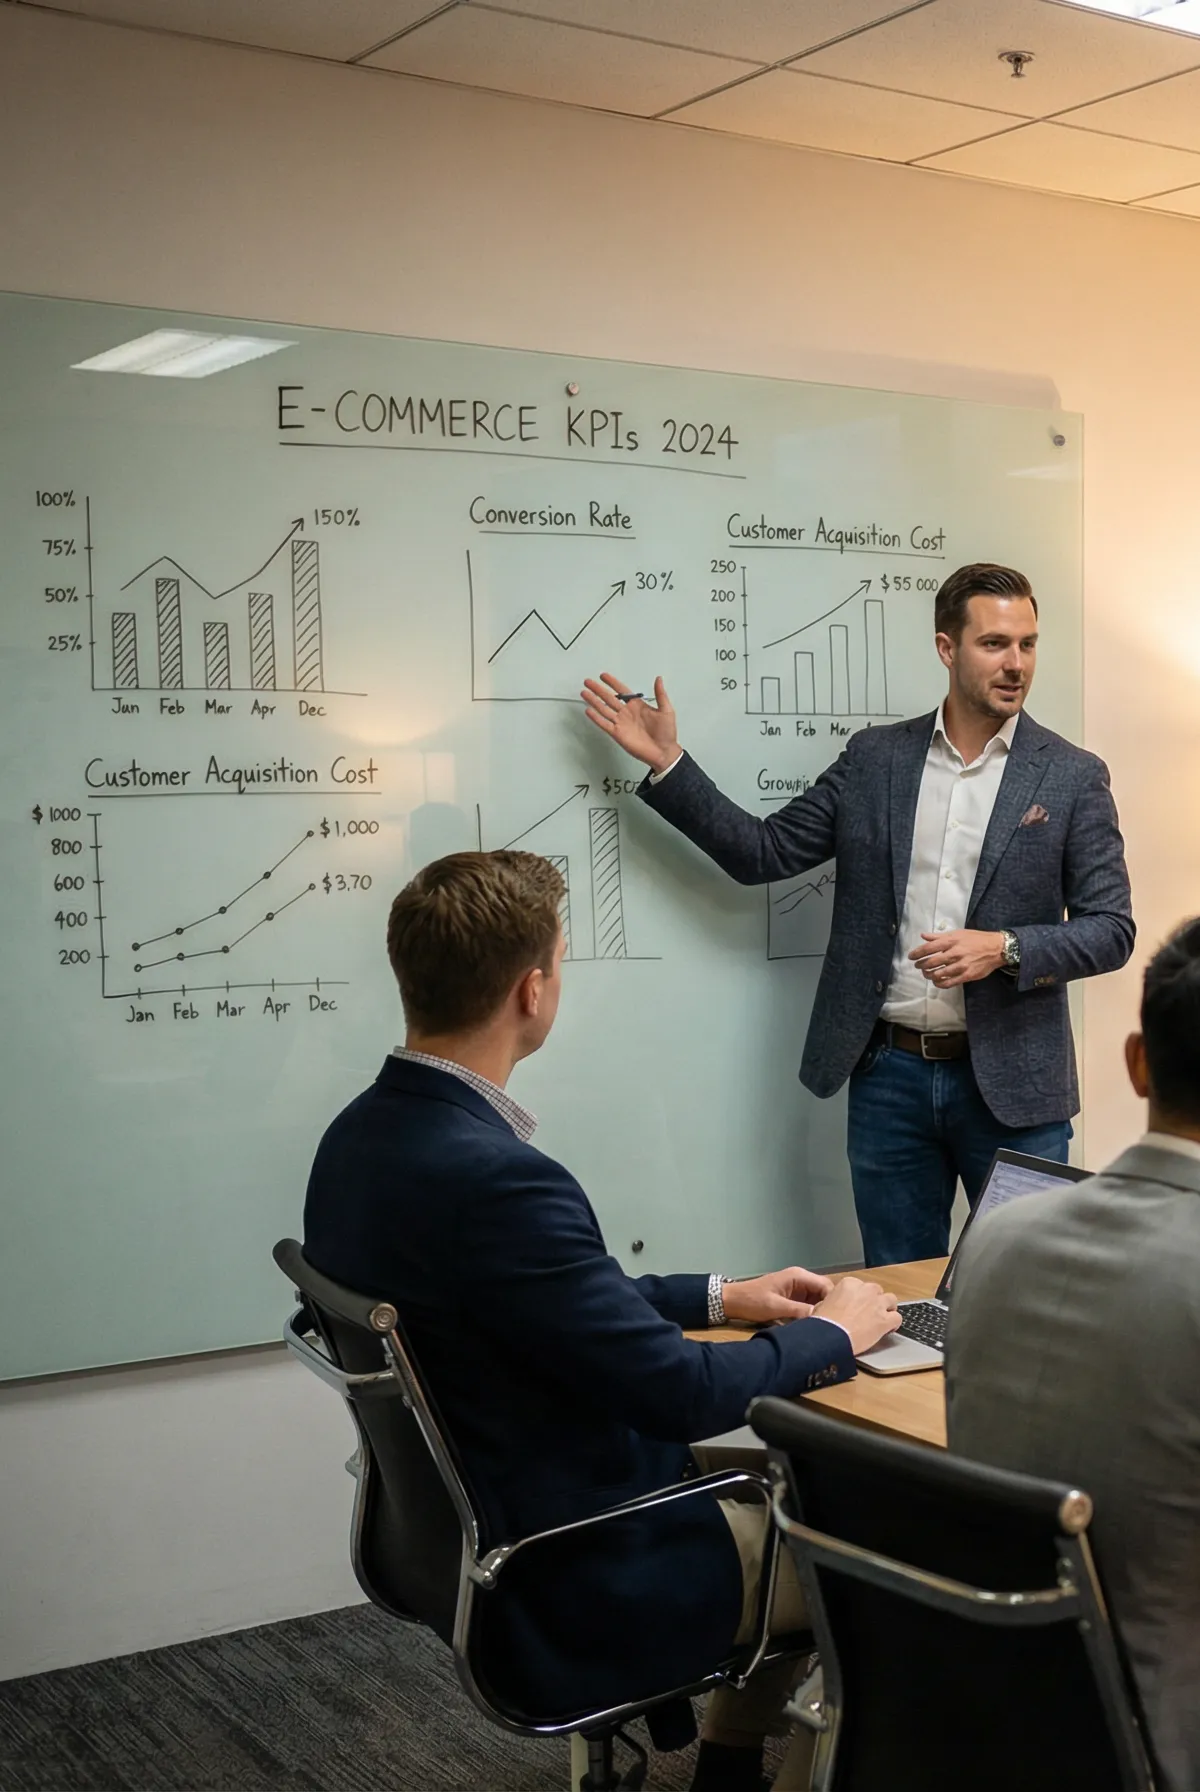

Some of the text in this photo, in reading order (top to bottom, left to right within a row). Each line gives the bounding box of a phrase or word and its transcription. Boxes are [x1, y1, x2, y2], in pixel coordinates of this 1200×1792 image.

[278, 386, 739, 460] E-COMMERCE KPIs 2024
[36, 490, 76, 507] 100%
[315, 508, 360, 526] 150%
[469, 496, 633, 529] Conversion Rate
[727, 513, 946, 554] Customer Acquisition Cost
[42, 539, 76, 556] 75%
[711, 560, 736, 573] 250
[635, 571, 674, 592] 30%
[45, 586, 79, 603] 50%
[711, 589, 735, 602] 200
[714, 618, 735, 632] 150
[48, 634, 82, 651] 25%
[715, 649, 736, 661] 100
[721, 677, 737, 690] 50
[160, 697, 185, 715] Feb
[205, 699, 233, 715] Mar
[251, 699, 277, 720] Apr
[299, 700, 326, 717] Dec
[760, 720, 781, 736] Jan
[830, 722, 851, 736] Mar
[85, 755, 378, 794] Customer Acquisition Cost
[51, 838, 82, 855] 800
[54, 874, 85, 892] 600
[54, 911, 88, 930] 400
[58, 949, 91, 965] 200
[126, 995, 337, 1023] Jan Feb Mar Apr Dec
